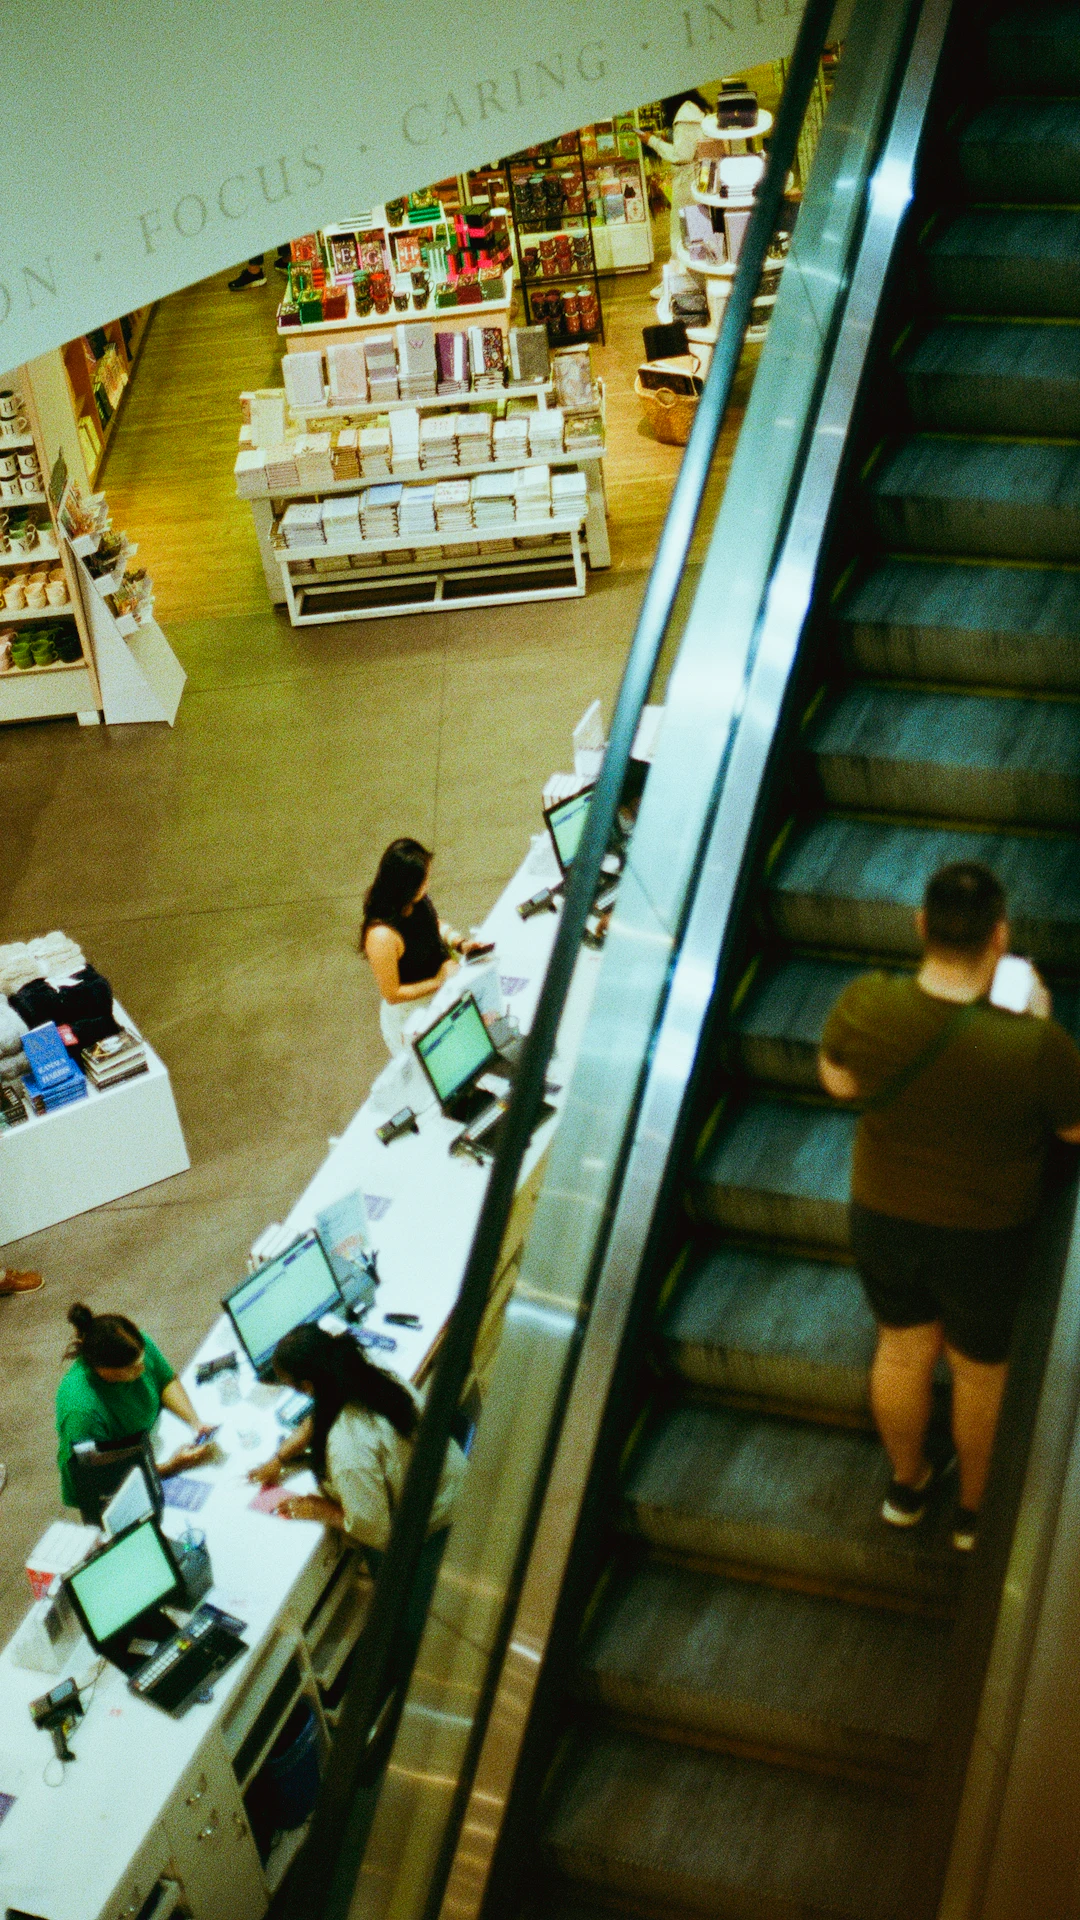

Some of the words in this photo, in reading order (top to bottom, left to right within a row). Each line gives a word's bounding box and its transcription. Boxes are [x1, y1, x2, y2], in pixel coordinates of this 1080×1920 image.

[138, 143, 325, 254] FOCUS
[401, 40, 606, 145] CARING
[341, 248, 351, 263] E
[404, 245, 415, 260] H
[367, 252, 379, 265] G
[3, 401, 14, 412] H
[5, 461, 12, 472] P
[24, 457, 37, 468] Q
[9, 484, 17, 495] P
[24, 481, 37, 492] Q
